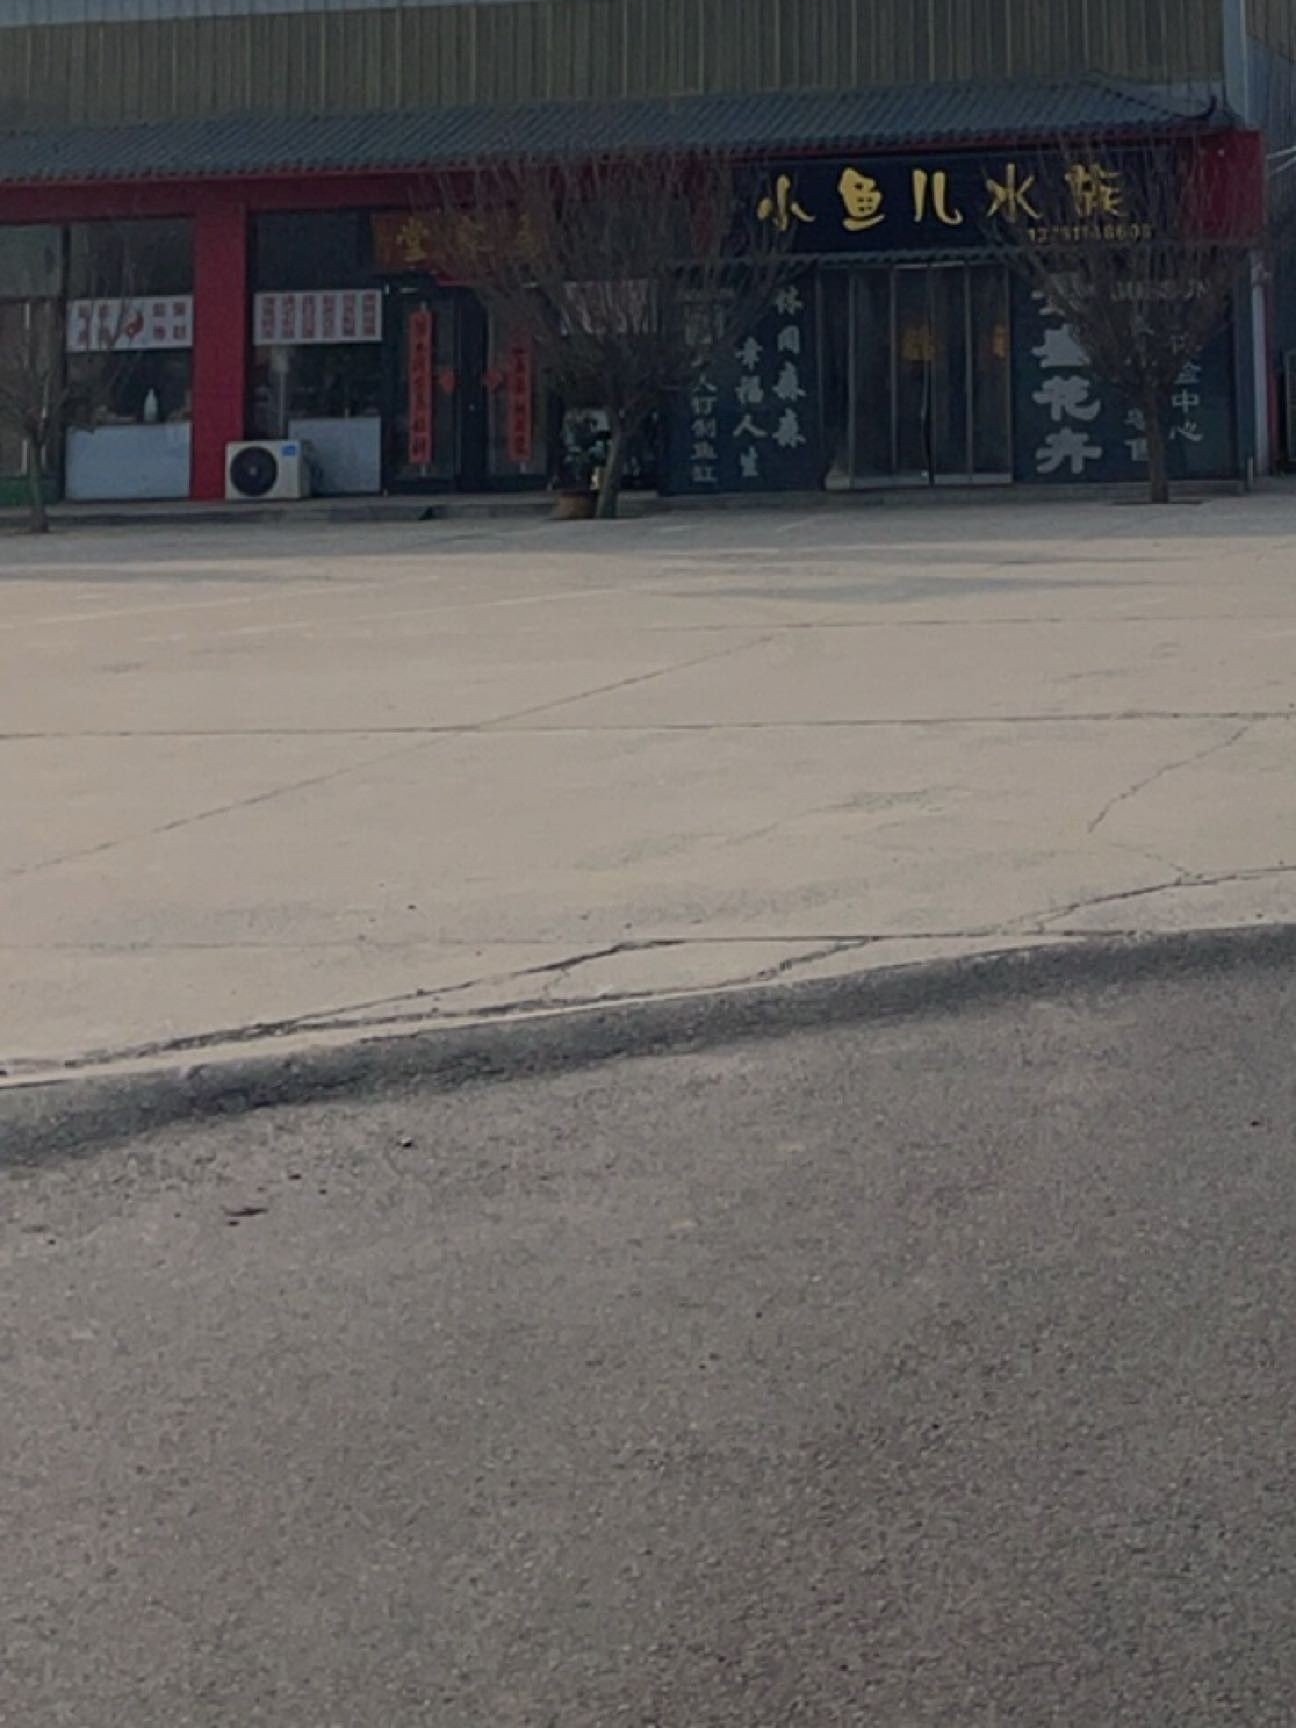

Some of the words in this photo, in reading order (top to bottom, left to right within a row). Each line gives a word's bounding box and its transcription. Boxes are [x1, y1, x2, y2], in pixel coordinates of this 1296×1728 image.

[756, 162, 1125, 232] 小鱼儿水族
